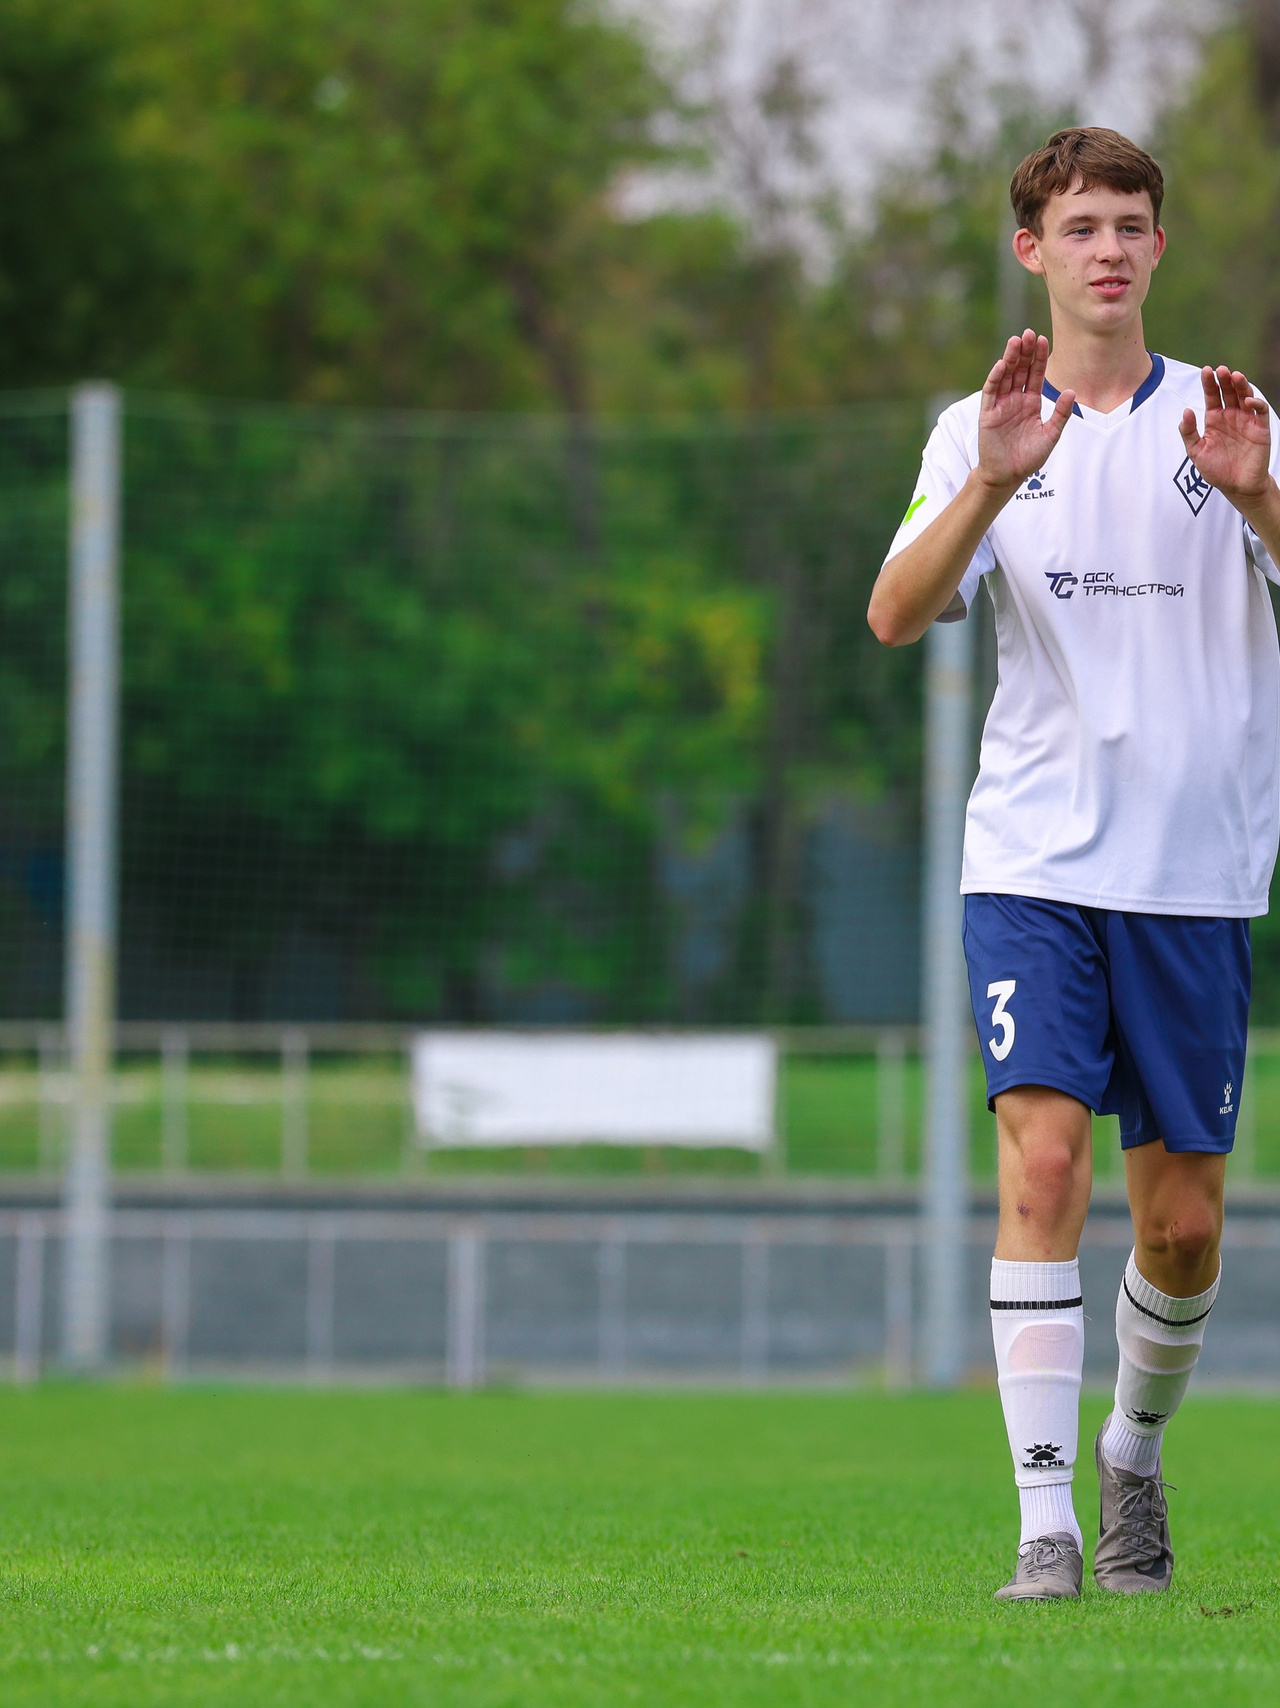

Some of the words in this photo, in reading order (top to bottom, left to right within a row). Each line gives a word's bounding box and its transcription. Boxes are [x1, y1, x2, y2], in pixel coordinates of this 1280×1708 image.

[1016, 489, 1055, 500] KELME
[1083, 572, 1115, 583] ДСК
[1083, 584, 1185, 597] ТРАНССТРОЙ
[986, 979, 1016, 1062] 3
[1023, 1459, 1065, 1468] KELME
